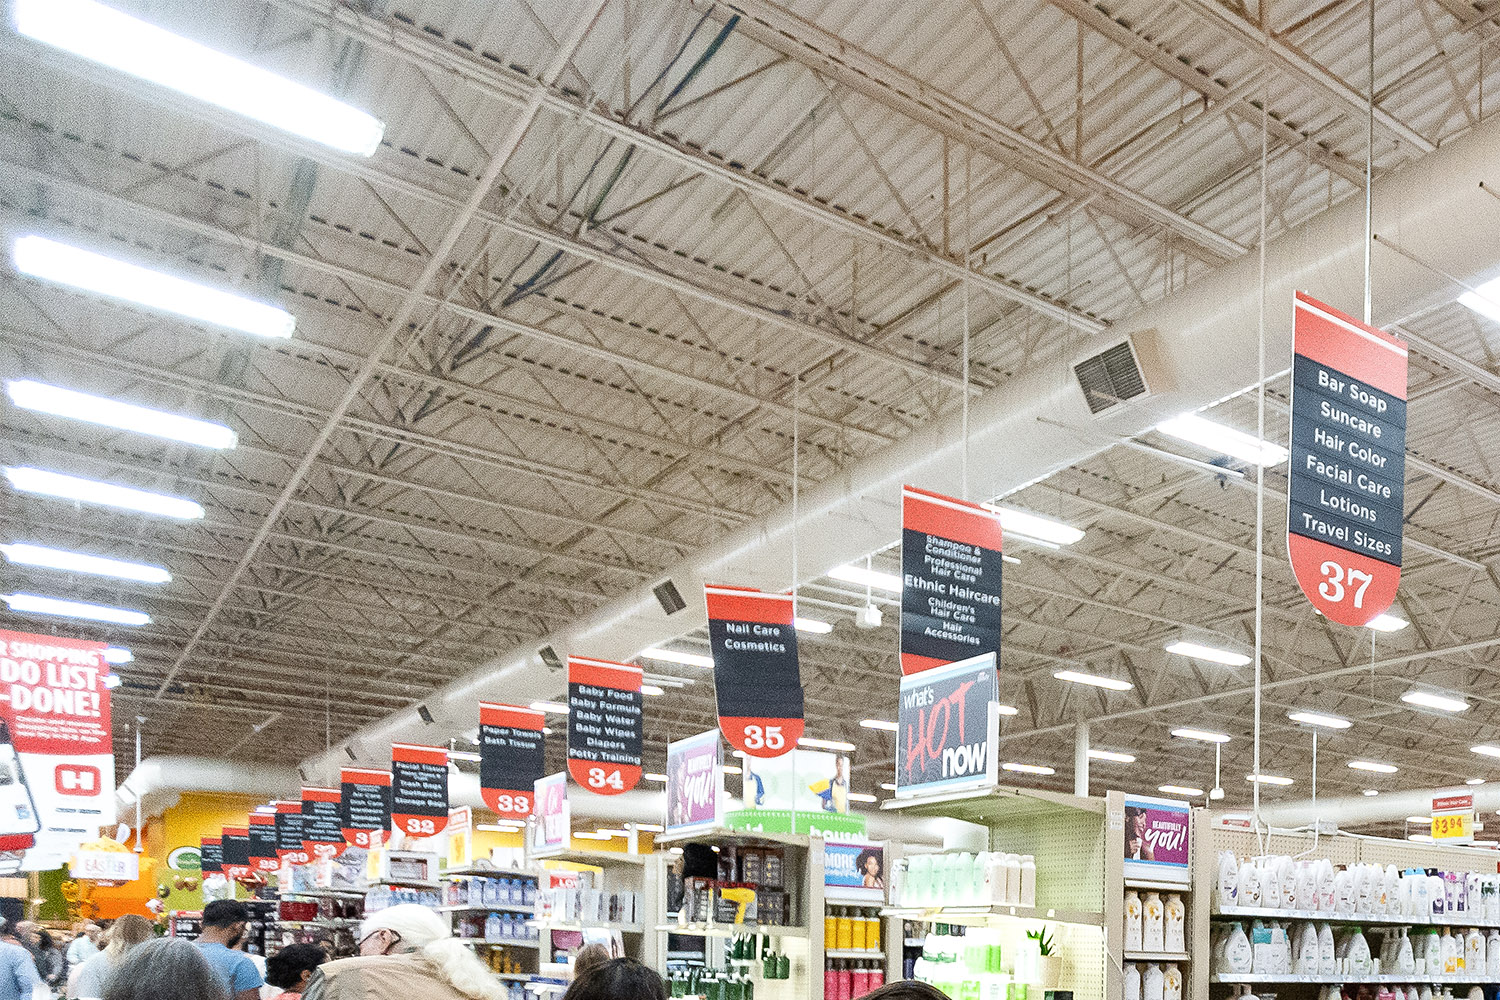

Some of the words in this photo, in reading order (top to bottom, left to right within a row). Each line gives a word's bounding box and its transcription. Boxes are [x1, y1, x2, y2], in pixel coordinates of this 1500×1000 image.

[1318, 370, 1345, 393] Bar
[1349, 383, 1388, 413] Soap
[1320, 401, 1382, 438] Suncare
[1314, 429, 1344, 452] Hair
[1348, 441, 1387, 468] Color
[1307, 455, 1352, 484] Facial
[1357, 473, 1392, 498] Care
[1320, 490, 1377, 522] Lotions
[926, 534, 971, 554] Shampoo
[974, 547, 981, 555] &
[1302, 513, 1348, 541] Travel
[1354, 530, 1392, 555] Sizes
[926, 544, 981, 564] Conditioner
[925, 555, 983, 576] Professional
[931, 566, 951, 577] Hair
[953, 570, 976, 582] Care
[904, 574, 946, 593] Ethnic
[949, 583, 1001, 606] Haircare
[1318, 561, 1374, 609] 37
[928, 597, 975, 614] Children's
[930, 607, 950, 617] Hair
[952, 611, 975, 623] Care
[726, 623, 750, 634] Nail
[753, 625, 780, 637] Care
[924, 627, 980, 645] Accessories
[942, 621, 963, 632] Hair
[10, 641, 98, 667] SHOPPING
[724, 638, 786, 653] Cosmetics
[1, 657, 41, 685] DO
[47, 661, 99, 691] LIST
[578, 685, 604, 697] Baby
[607, 691, 633, 700] Food
[904, 686, 935, 710] what's
[570, 697, 596, 710] Baby
[599, 701, 641, 715] Formula
[576, 710, 601, 723] Baby
[605, 714, 635, 725] Water
[482, 725, 509, 736] Paper
[512, 729, 542, 739] Towels
[575, 722, 601, 736] Baby
[604, 727, 636, 739] Wipes
[744, 726, 785, 749] 35
[905, 680, 975, 778] HOT
[484, 736, 506, 745] Bath
[508, 740, 536, 749] Tissue
[586, 737, 625, 750] Diapers
[569, 748, 598, 760] Potty
[601, 751, 641, 765] Training
[942, 742, 986, 777] now
[588, 768, 624, 790] 34
[684, 756, 716, 819] you!
[497, 794, 530, 813] 33
[407, 818, 435, 834] 32
[1145, 826, 1186, 853] you!
